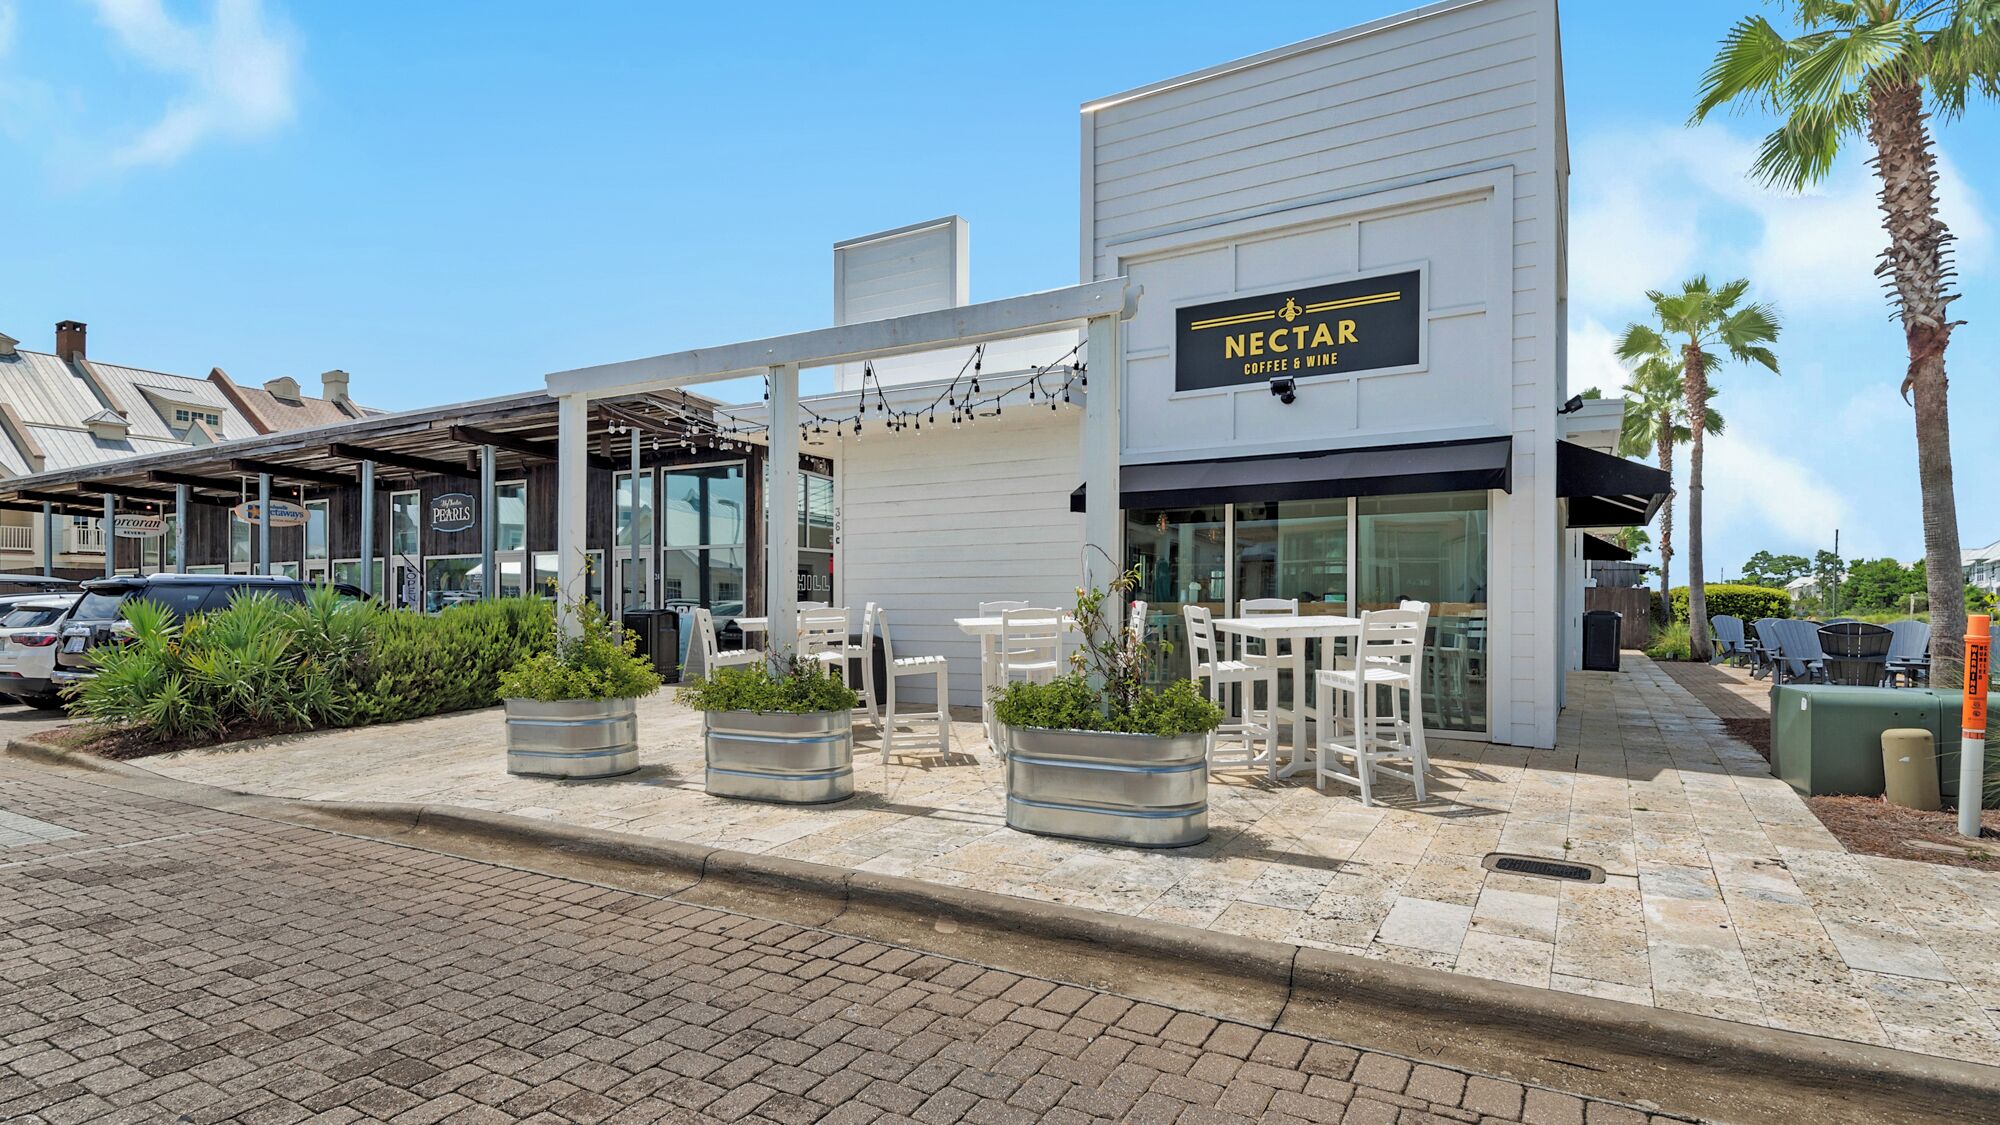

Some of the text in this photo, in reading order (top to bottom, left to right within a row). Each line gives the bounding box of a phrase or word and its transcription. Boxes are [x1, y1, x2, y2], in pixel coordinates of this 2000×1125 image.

[1225, 319, 1359, 359] NECTAR
[1243, 352, 1338, 375] COFFEE & WINE
[114, 518, 161, 528] orcoran
[268, 509, 304, 520] etaways
[433, 506, 470, 524] PEARLS
[406, 572, 417, 602] OPEN
[1969, 645, 1978, 694] WARNING
